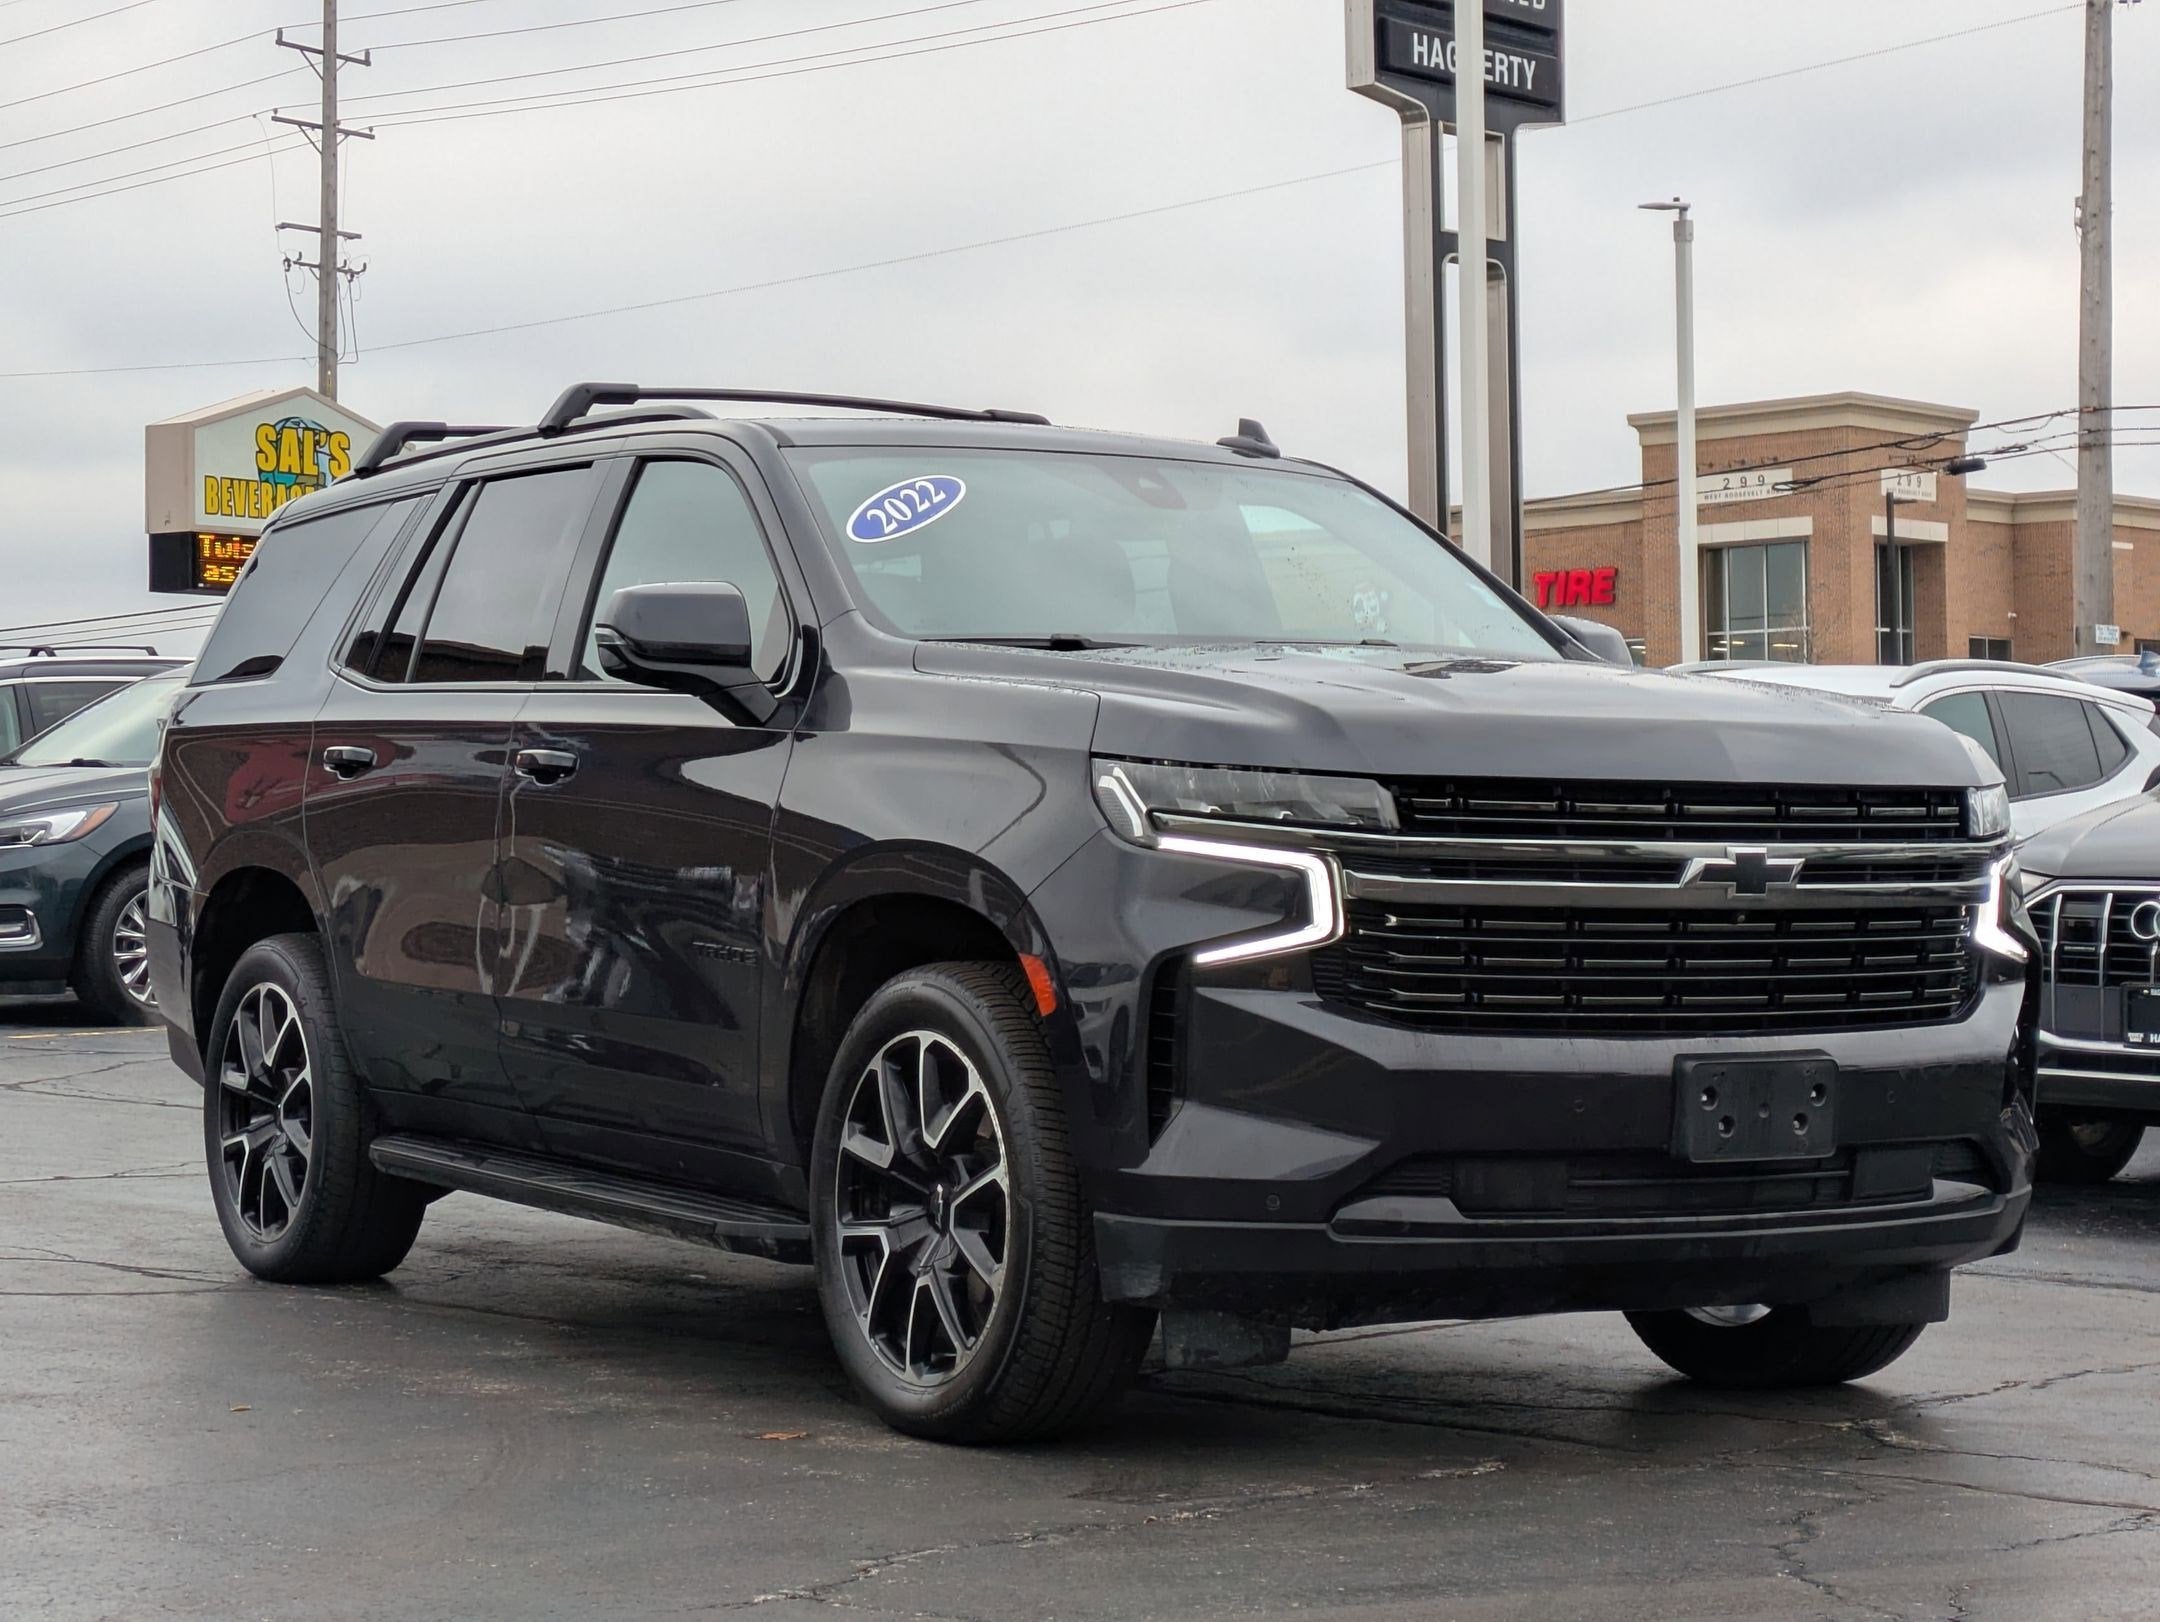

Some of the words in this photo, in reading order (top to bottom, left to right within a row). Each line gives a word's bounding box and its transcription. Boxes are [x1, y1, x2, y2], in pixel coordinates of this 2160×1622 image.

[1412, 32, 1537, 90] HAGERTY
[255, 423, 351, 478] SAL'S
[204, 475, 316, 519] BEVERA
[1722, 474, 1766, 490] 299
[866, 480, 947, 534] 2022
[1533, 566, 1618, 609] TIRE
